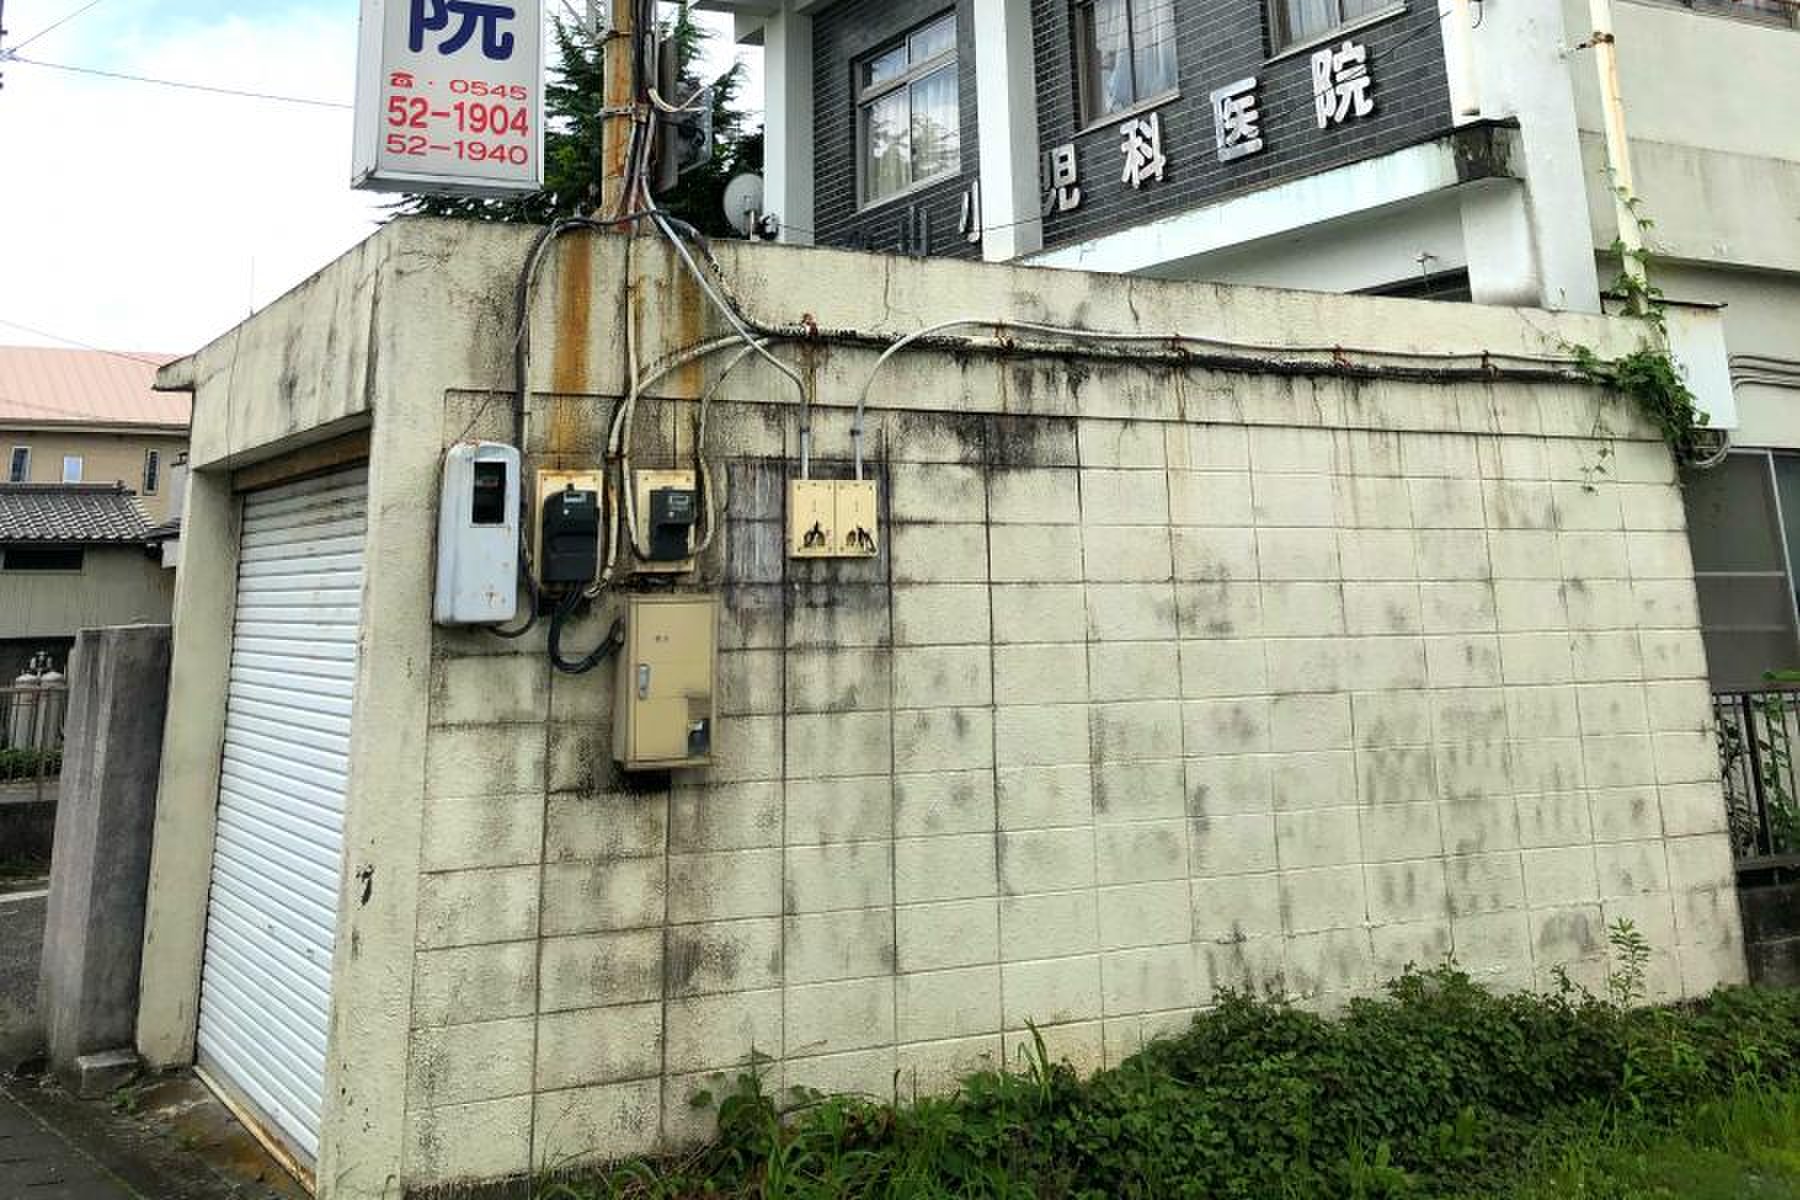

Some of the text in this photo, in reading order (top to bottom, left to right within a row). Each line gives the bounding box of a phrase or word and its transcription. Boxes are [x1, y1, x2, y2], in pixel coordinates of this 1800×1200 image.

[449, 79, 528, 101] 0545
[387, 95, 529, 137] 52-1904
[386, 133, 528, 165] 52-1940
